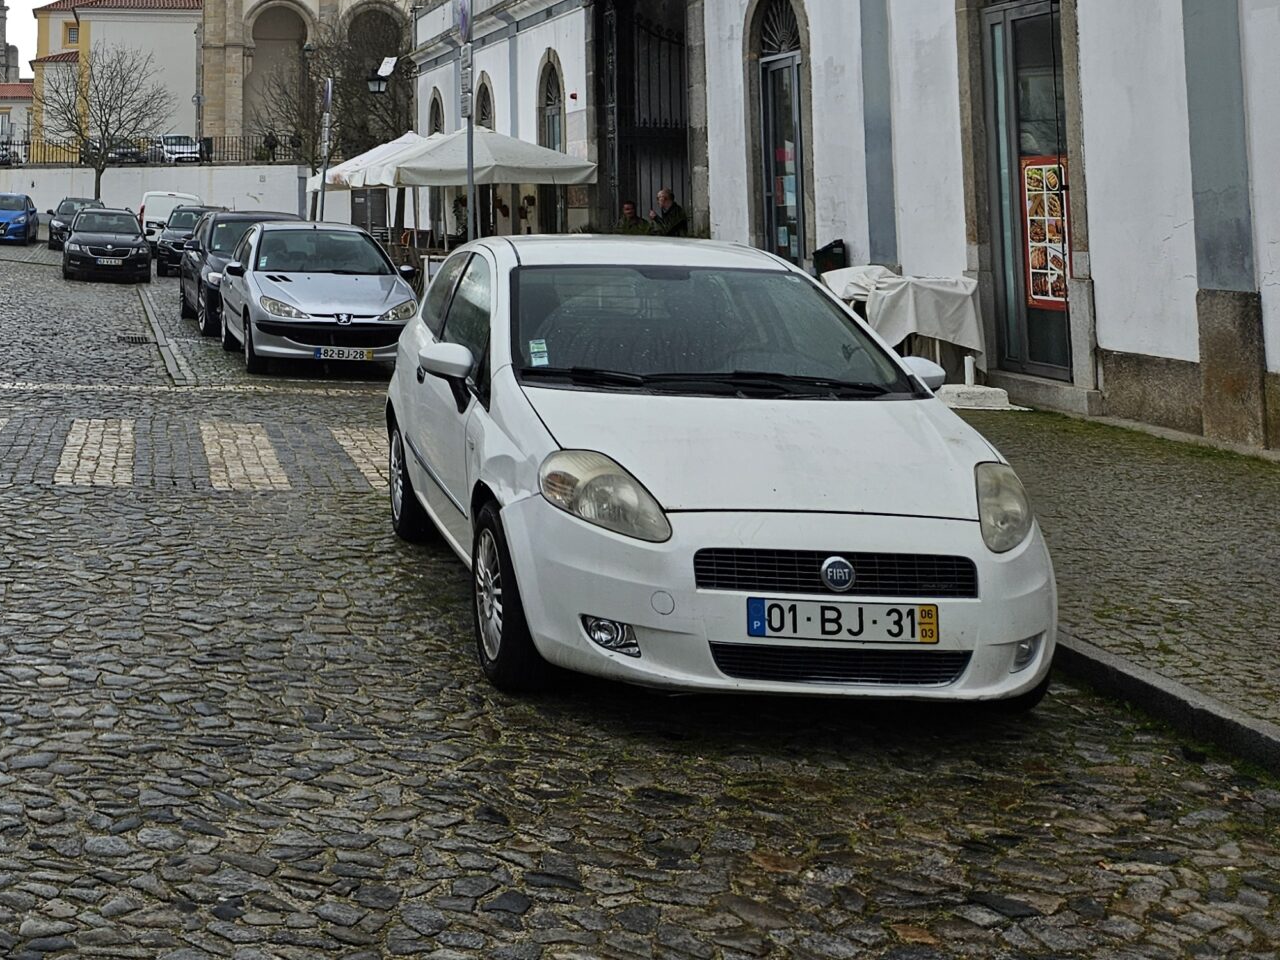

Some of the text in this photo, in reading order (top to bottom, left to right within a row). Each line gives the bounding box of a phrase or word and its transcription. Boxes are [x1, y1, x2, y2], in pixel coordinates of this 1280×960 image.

[827, 568, 850, 580] FIAT
[920, 609, 933, 620] 06
[753, 620, 761, 630] P
[920, 628, 934, 639] 03
